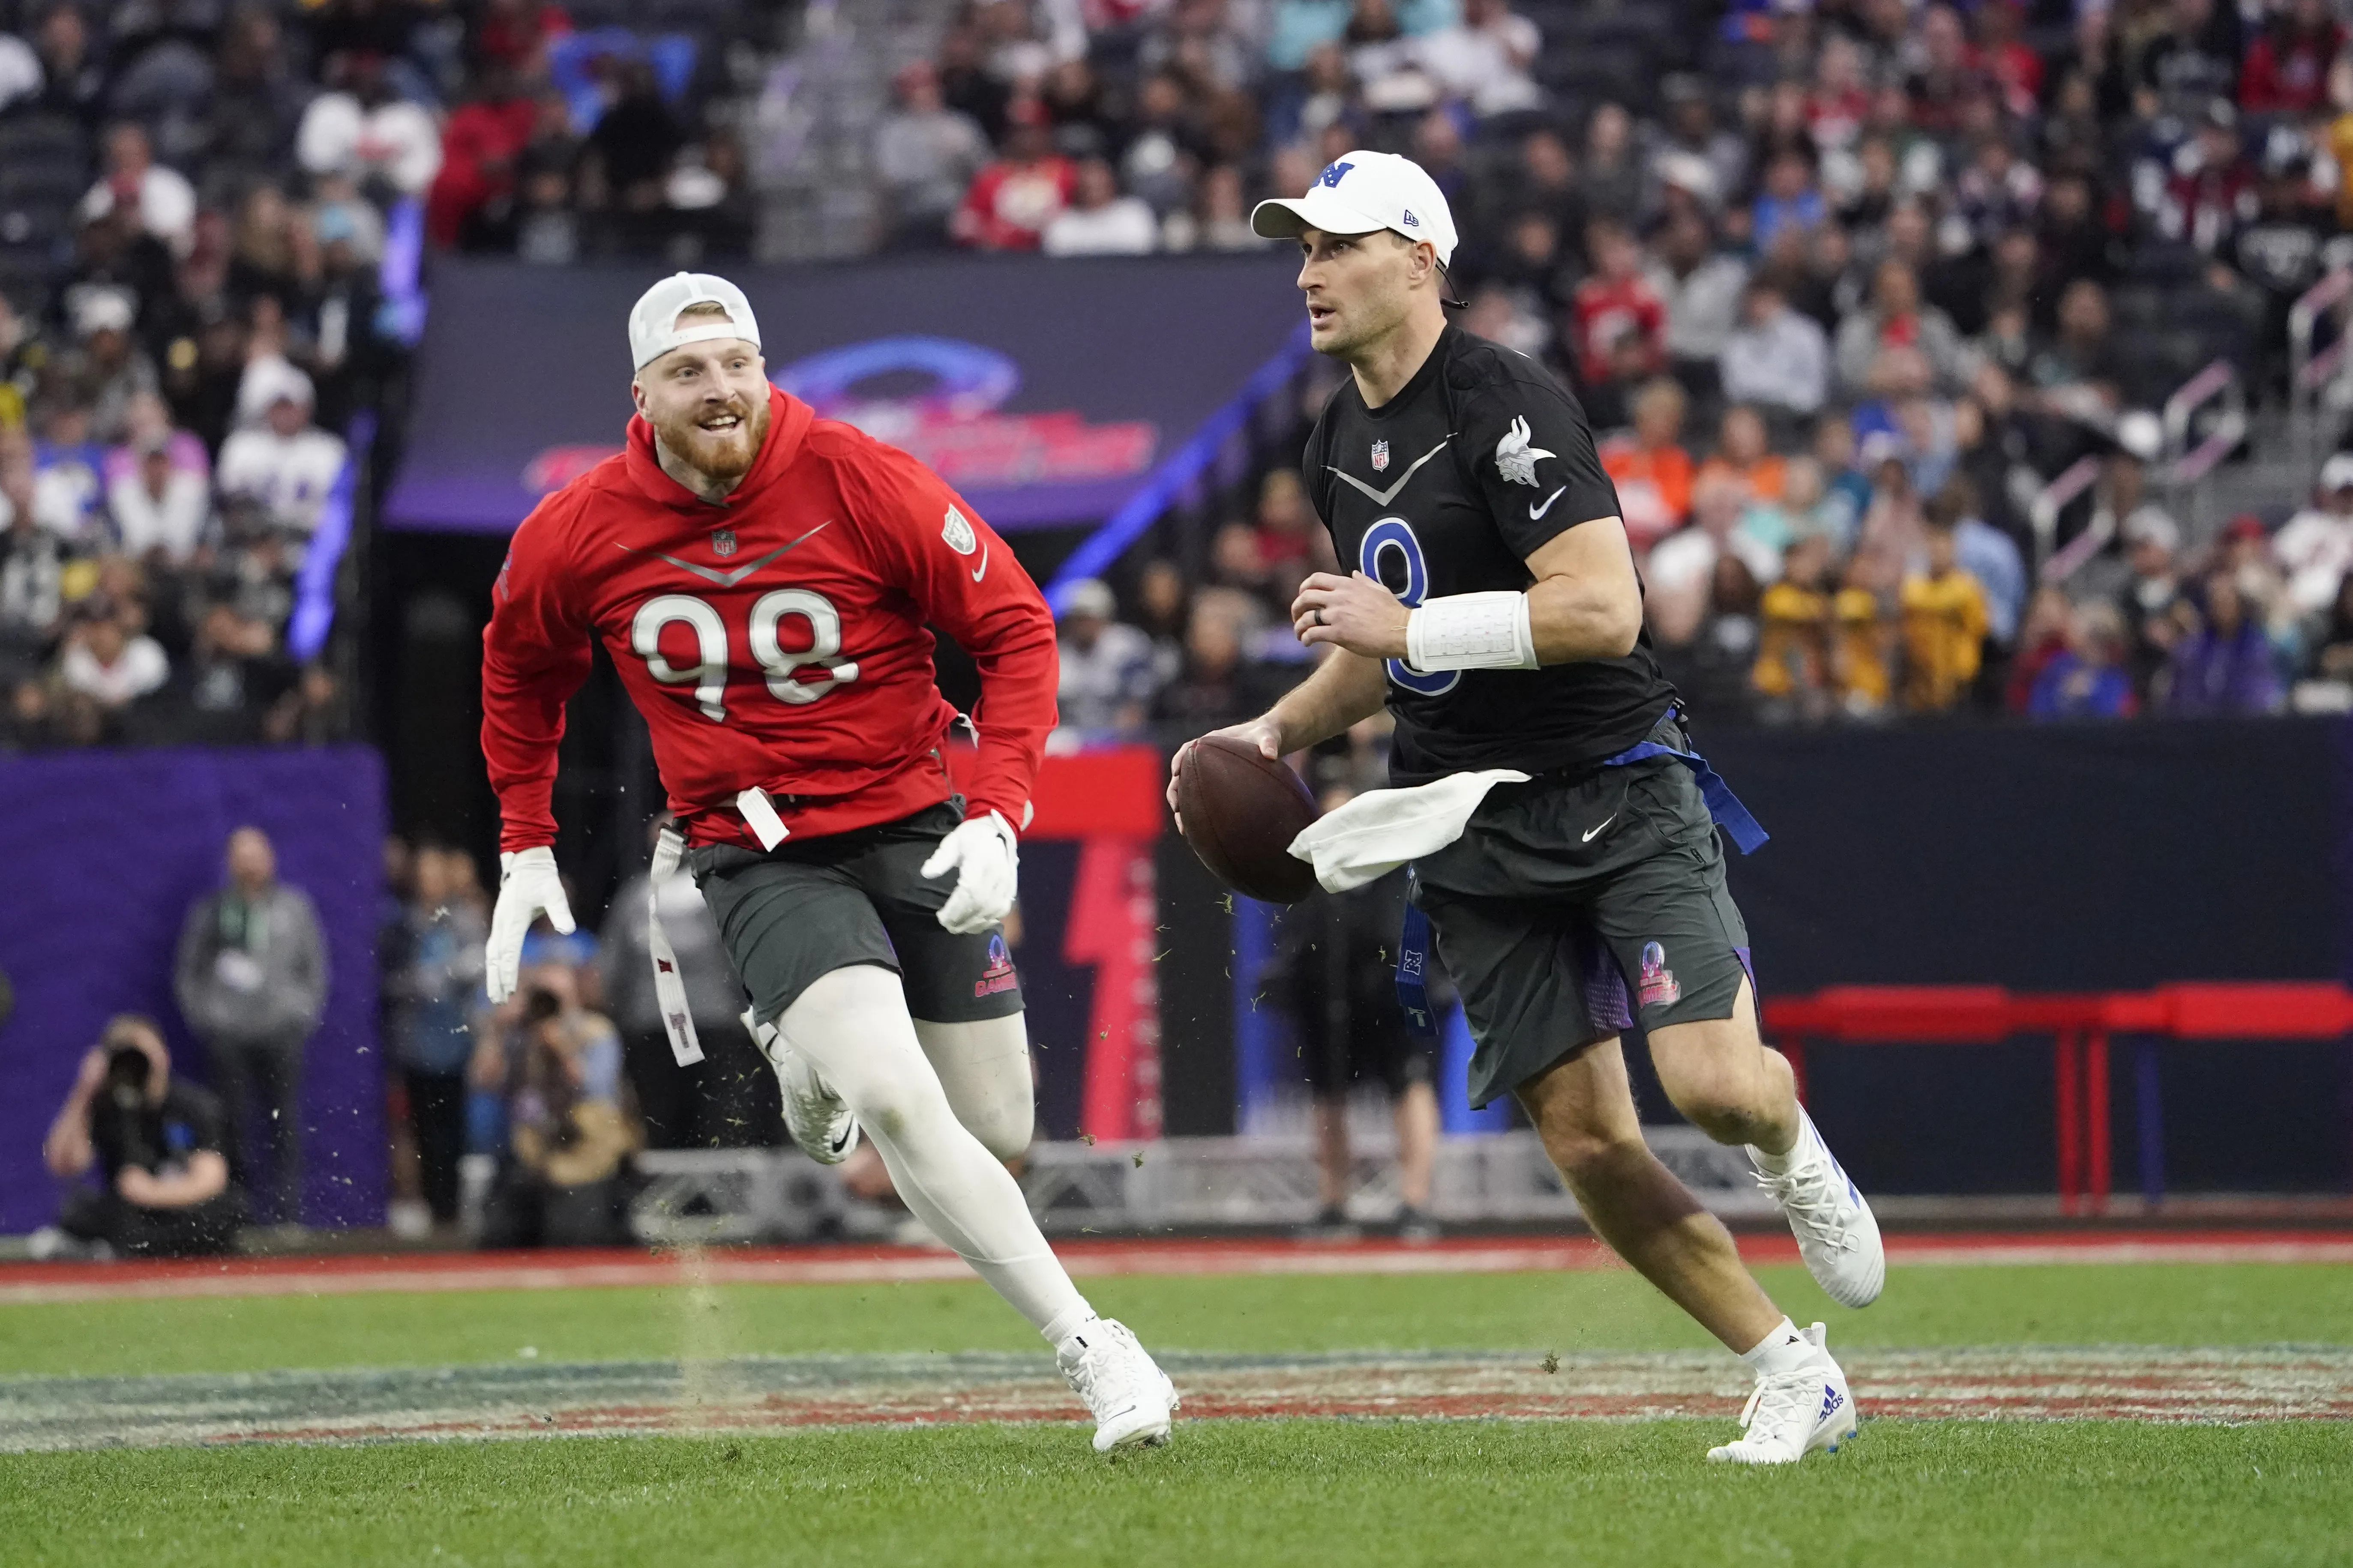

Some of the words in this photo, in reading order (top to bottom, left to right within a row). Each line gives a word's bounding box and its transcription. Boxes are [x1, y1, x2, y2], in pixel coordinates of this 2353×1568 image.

[1309, 162, 1355, 188] N
[1374, 453, 1387, 467] NFL
[716, 540, 734, 553] NFL
[632, 588, 859, 722] 98
